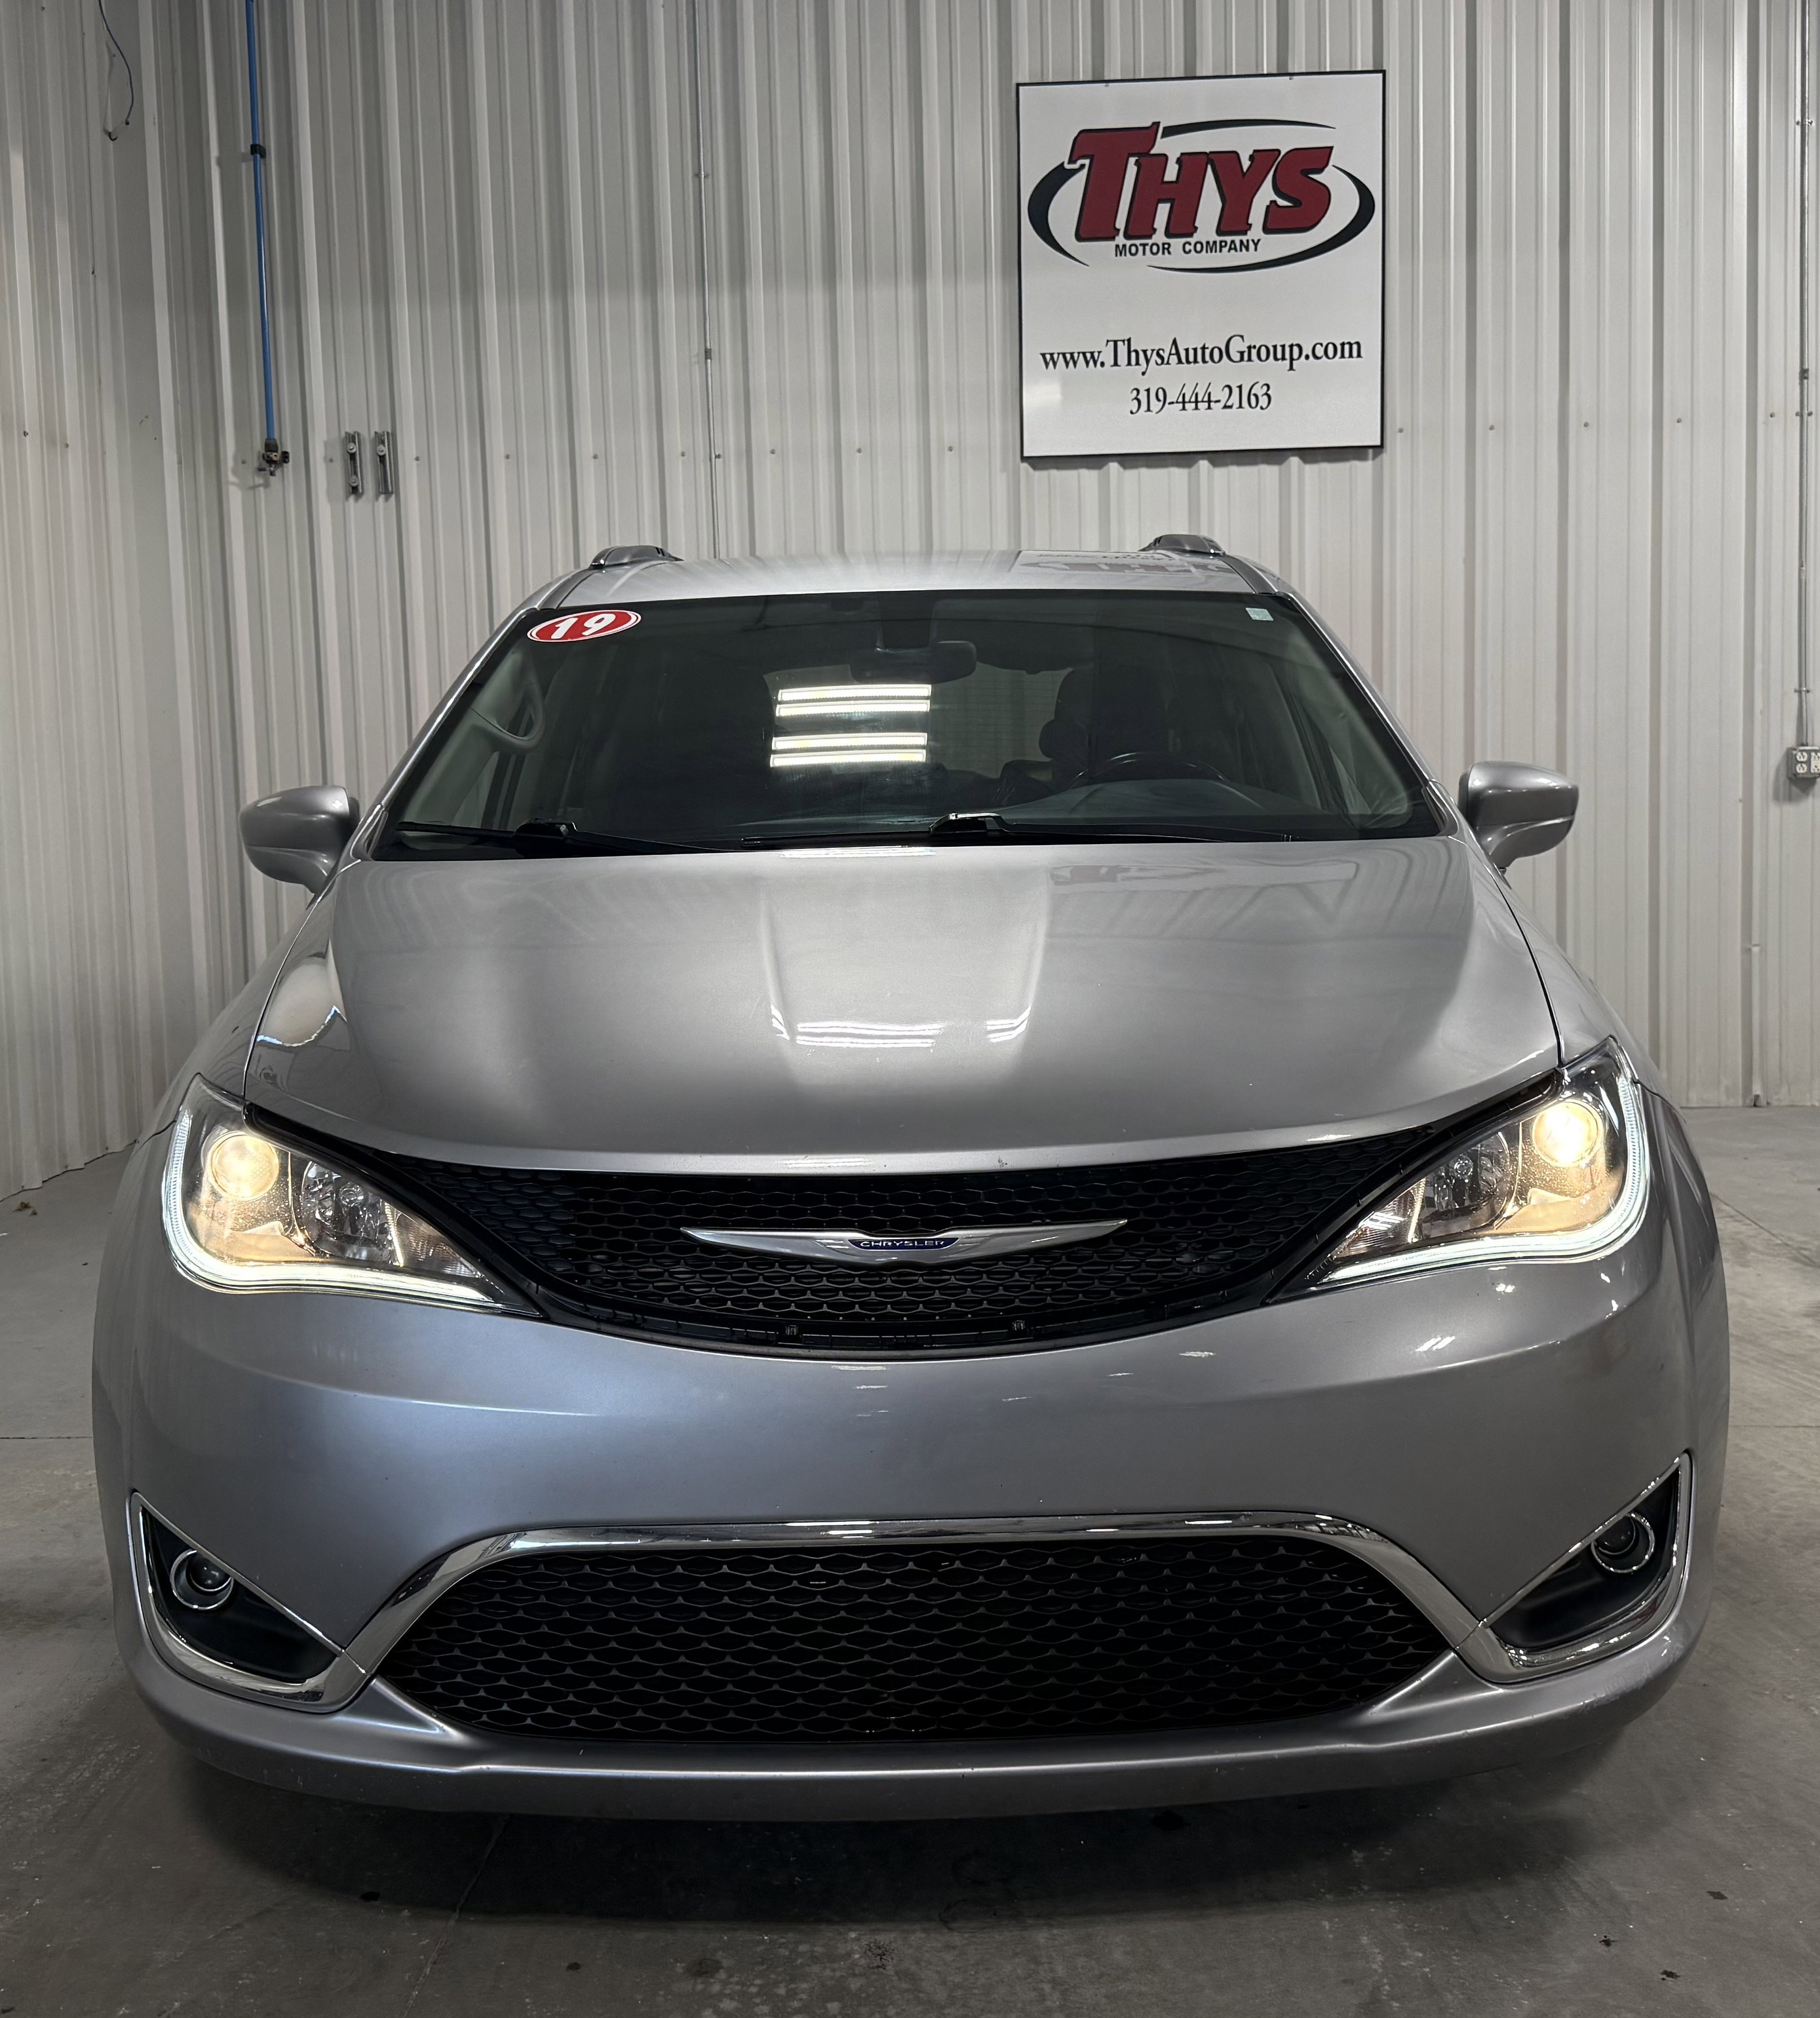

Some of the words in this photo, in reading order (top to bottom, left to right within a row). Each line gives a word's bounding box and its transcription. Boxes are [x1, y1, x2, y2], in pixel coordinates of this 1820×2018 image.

[1068, 121, 1333, 242] THYS
[1115, 242, 1172, 257] MOTOR
[1182, 238, 1261, 254] COMPANY
[1040, 334, 1363, 375] www.ThysAutoGroup.com
[1129, 381, 1272, 414] 319-444-2163
[551, 614, 616, 639] 19
